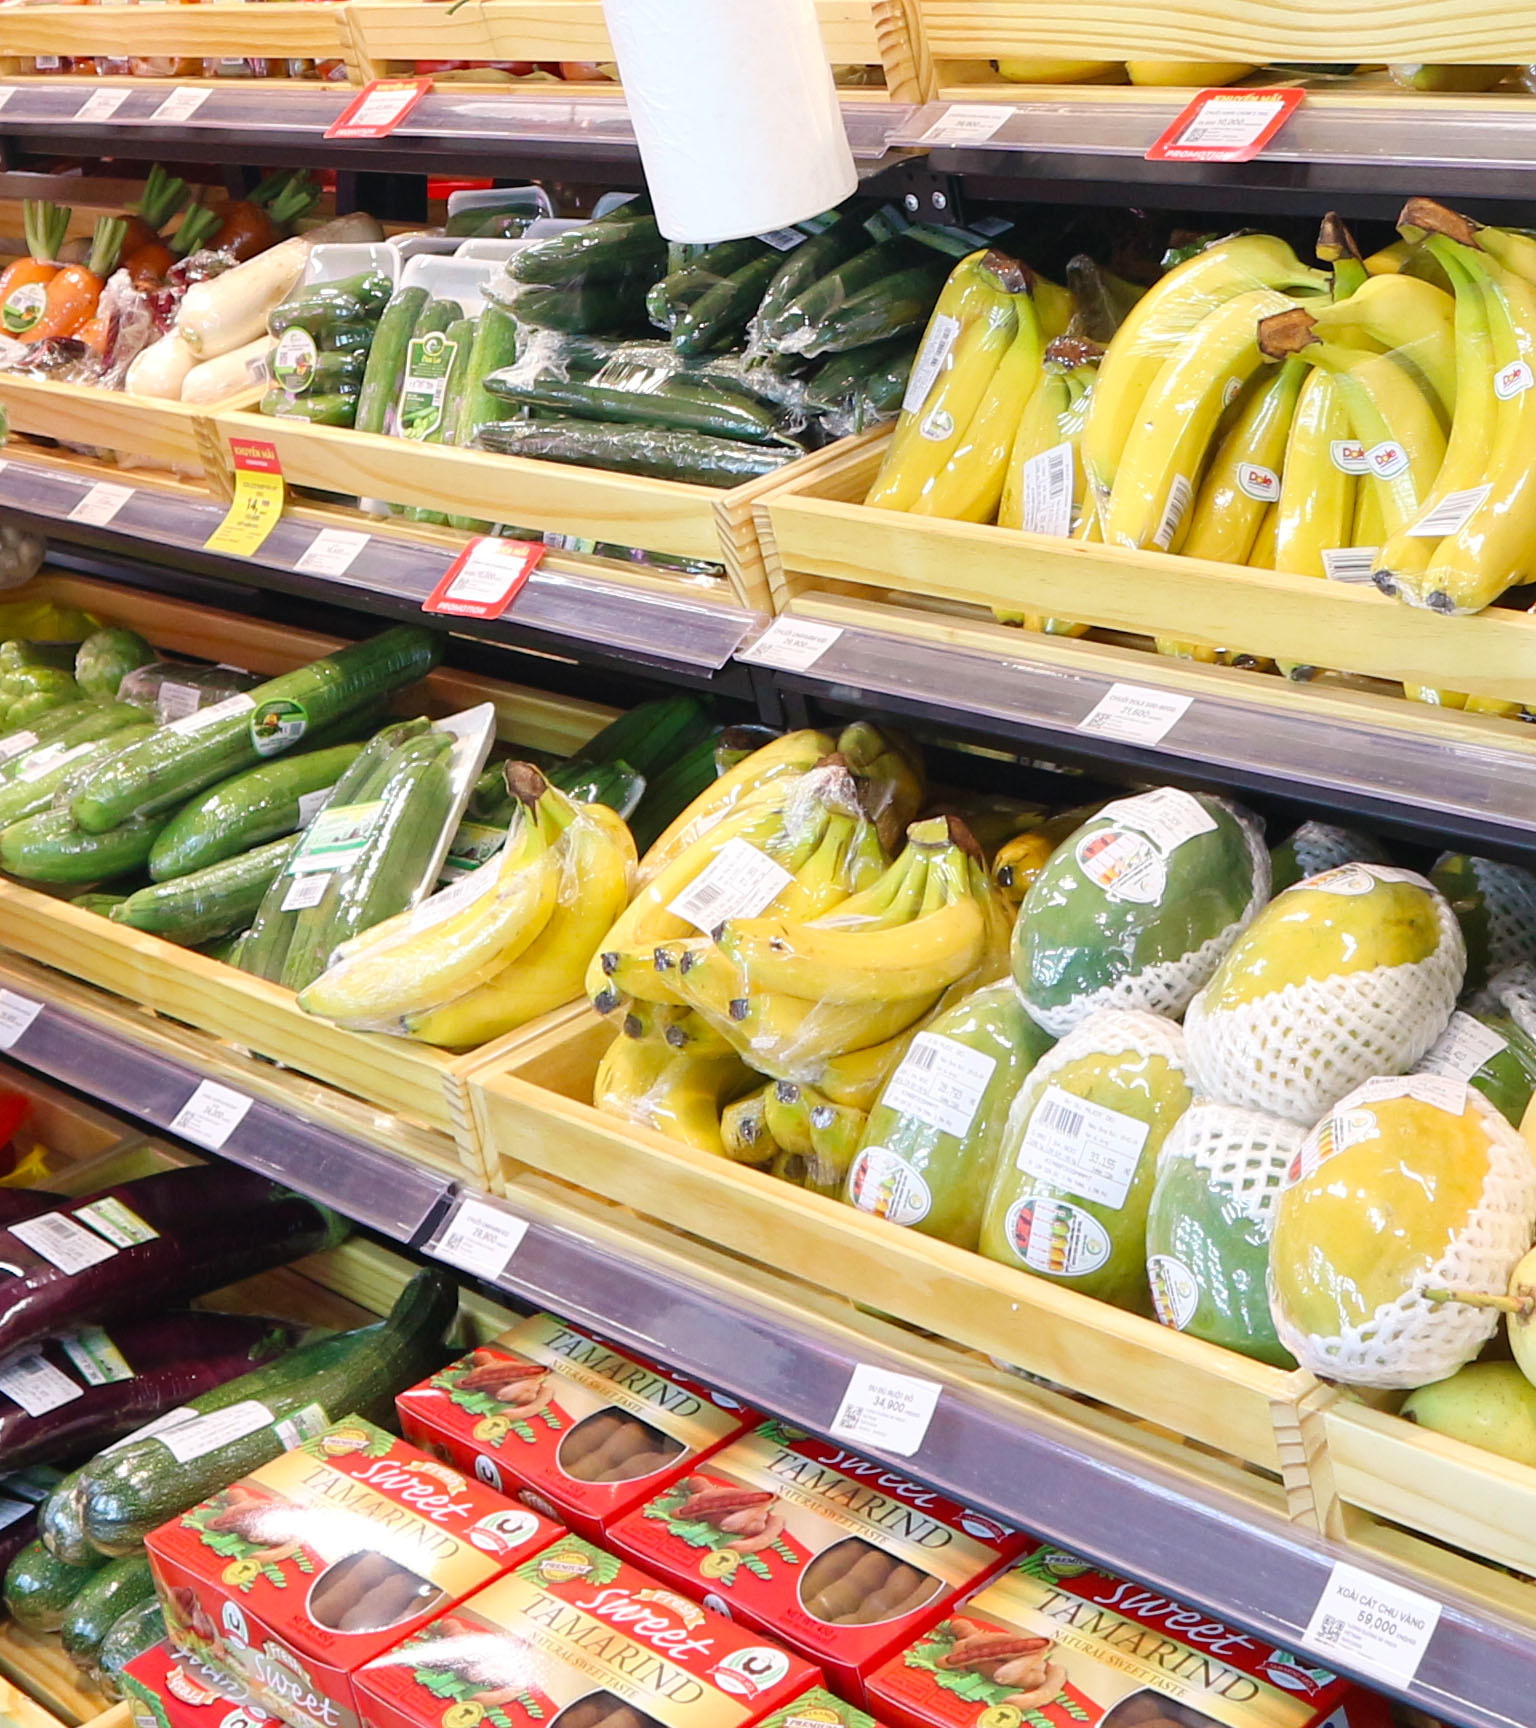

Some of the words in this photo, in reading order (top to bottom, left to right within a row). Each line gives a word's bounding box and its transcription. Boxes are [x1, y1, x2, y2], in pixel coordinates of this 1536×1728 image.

[1502, 366, 1523, 389] Dole
[1375, 447, 1398, 466] Dole
[1249, 470, 1273, 488] Dole
[437, 601, 487, 614] PROMOTION
[544, 1328, 702, 1420] TAMARIND
[872, 1395, 906, 1413] 34,900
[321, 1436, 369, 1449] PREMIUM
[422, 1462, 463, 1494] Fresh
[300, 1465, 461, 1561] TAMARIND
[763, 1449, 954, 1552] TAMARIND
[778, 1484, 819, 1517] NATURAL
[855, 1520, 889, 1546] TASTE
[540, 1562, 594, 1575] PREMIUM
[1046, 1553, 1094, 1568] PREMI
[654, 1589, 700, 1621] Fresh
[1335, 1584, 1360, 1603] XOÀI
[1359, 1595, 1378, 1610] CÁT
[1378, 1603, 1400, 1619] CHU
[1399, 1610, 1427, 1631] VÀNG
[1357, 1610, 1398, 1636] 59,000
[517, 1592, 706, 1705] TAMARIND
[1031, 1588, 1262, 1703] TAMARIND
[1050, 1629, 1108, 1665] NATURAL
[1106, 1654, 1154, 1684] SWEET
[1150, 1670, 1192, 1699] TASTE
[603, 1672, 641, 1700] TASTE
